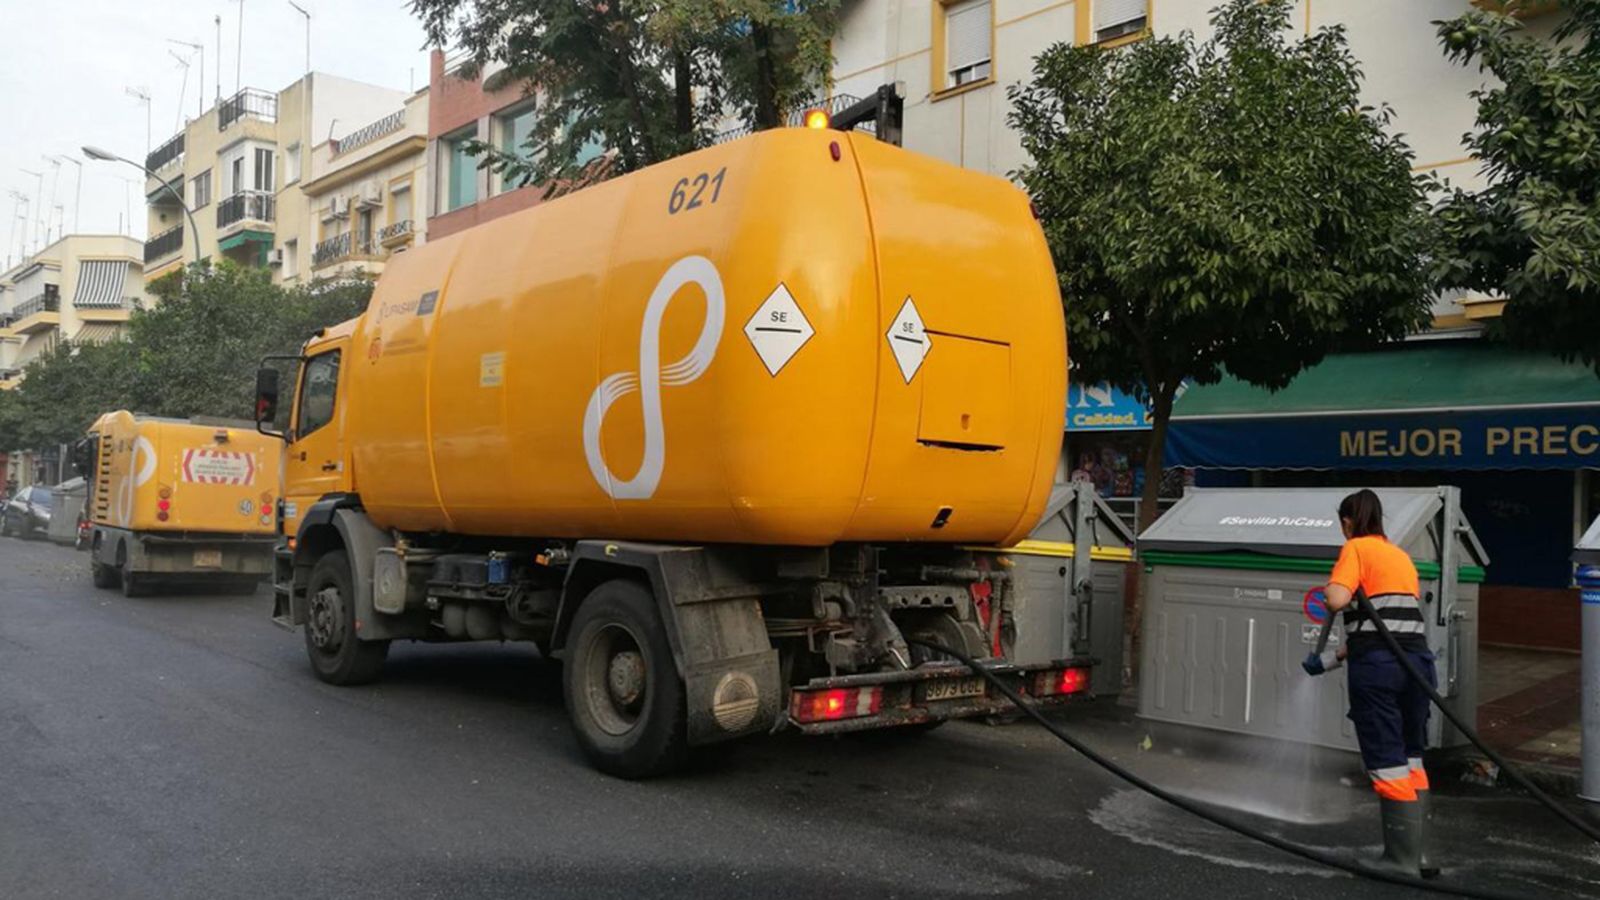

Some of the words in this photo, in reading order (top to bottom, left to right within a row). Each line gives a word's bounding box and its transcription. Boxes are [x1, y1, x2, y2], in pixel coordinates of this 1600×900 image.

[668, 166, 727, 215] 621
[770, 311, 787, 323] SE
[902, 322, 914, 334] SE
[1340, 428, 1462, 457] MEJOR
[1486, 424, 1600, 456] PREC
[1219, 516, 1334, 528] #SevillaTuCasa
